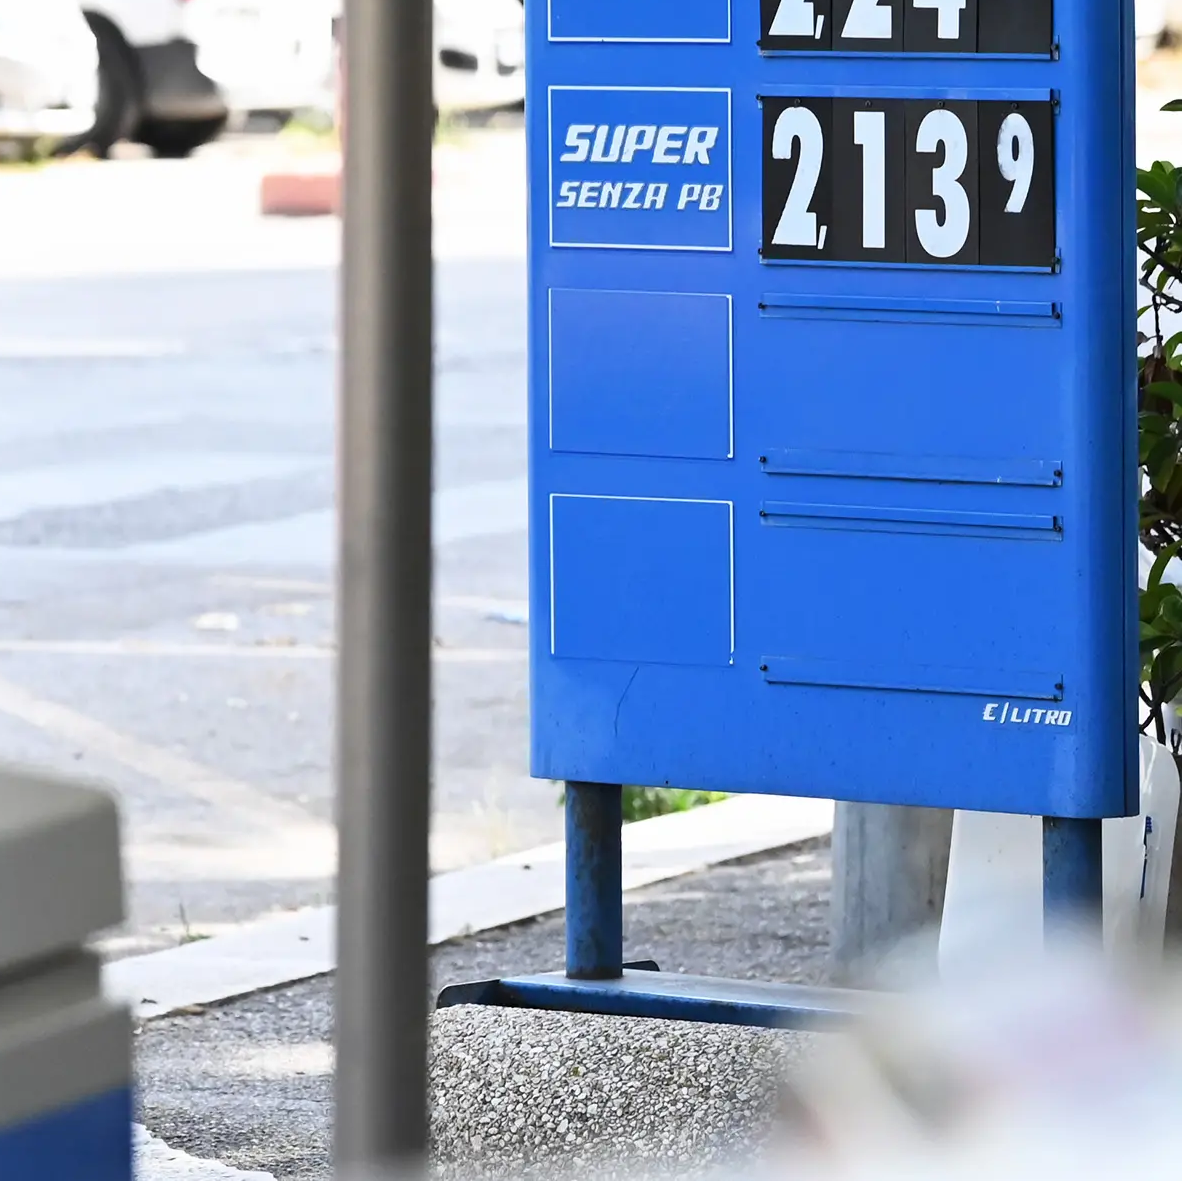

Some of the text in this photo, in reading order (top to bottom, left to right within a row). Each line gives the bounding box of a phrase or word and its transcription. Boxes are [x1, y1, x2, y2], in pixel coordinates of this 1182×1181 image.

[560, 124, 719, 165] SUPER
[556, 181, 724, 211] SENZA PB
